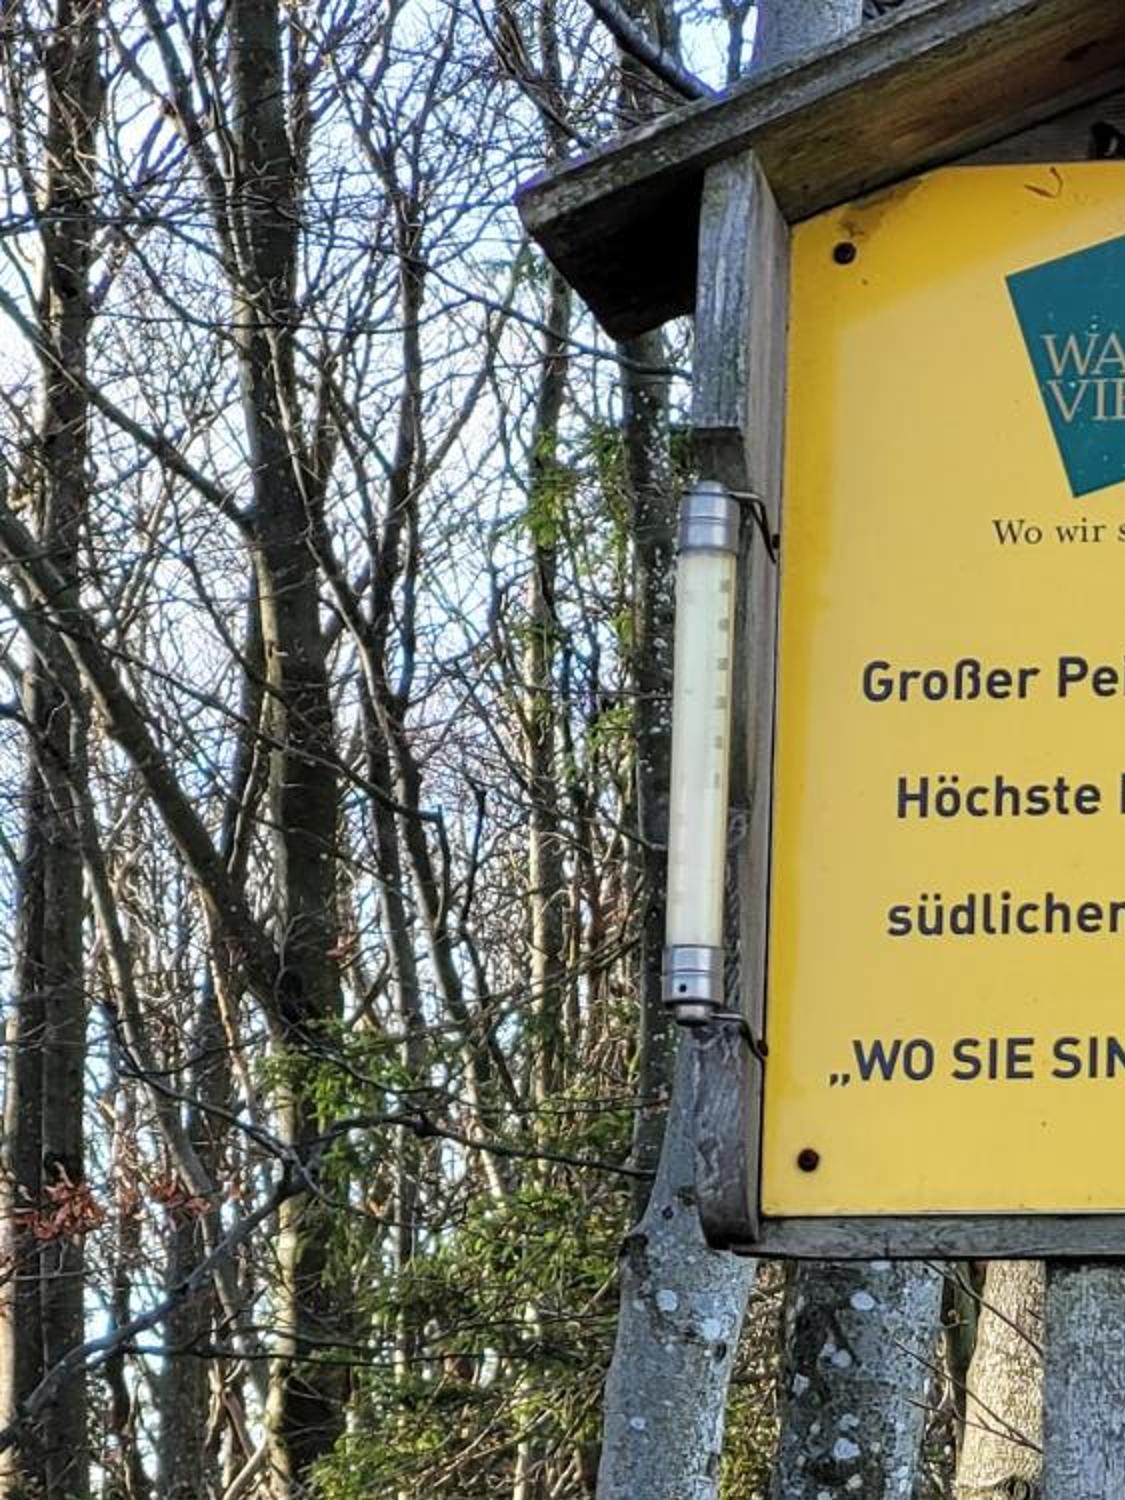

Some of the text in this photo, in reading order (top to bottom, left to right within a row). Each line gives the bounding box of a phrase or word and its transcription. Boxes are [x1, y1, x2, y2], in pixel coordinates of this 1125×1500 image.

[992, 518, 1043, 546] Wo
[1055, 516, 1108, 545] wir
[862, 656, 1041, 703] Großer
[897, 774, 1102, 819] Höchste
[829, 1038, 935, 1088] „WO
[950, 1037, 1036, 1081] SIE
